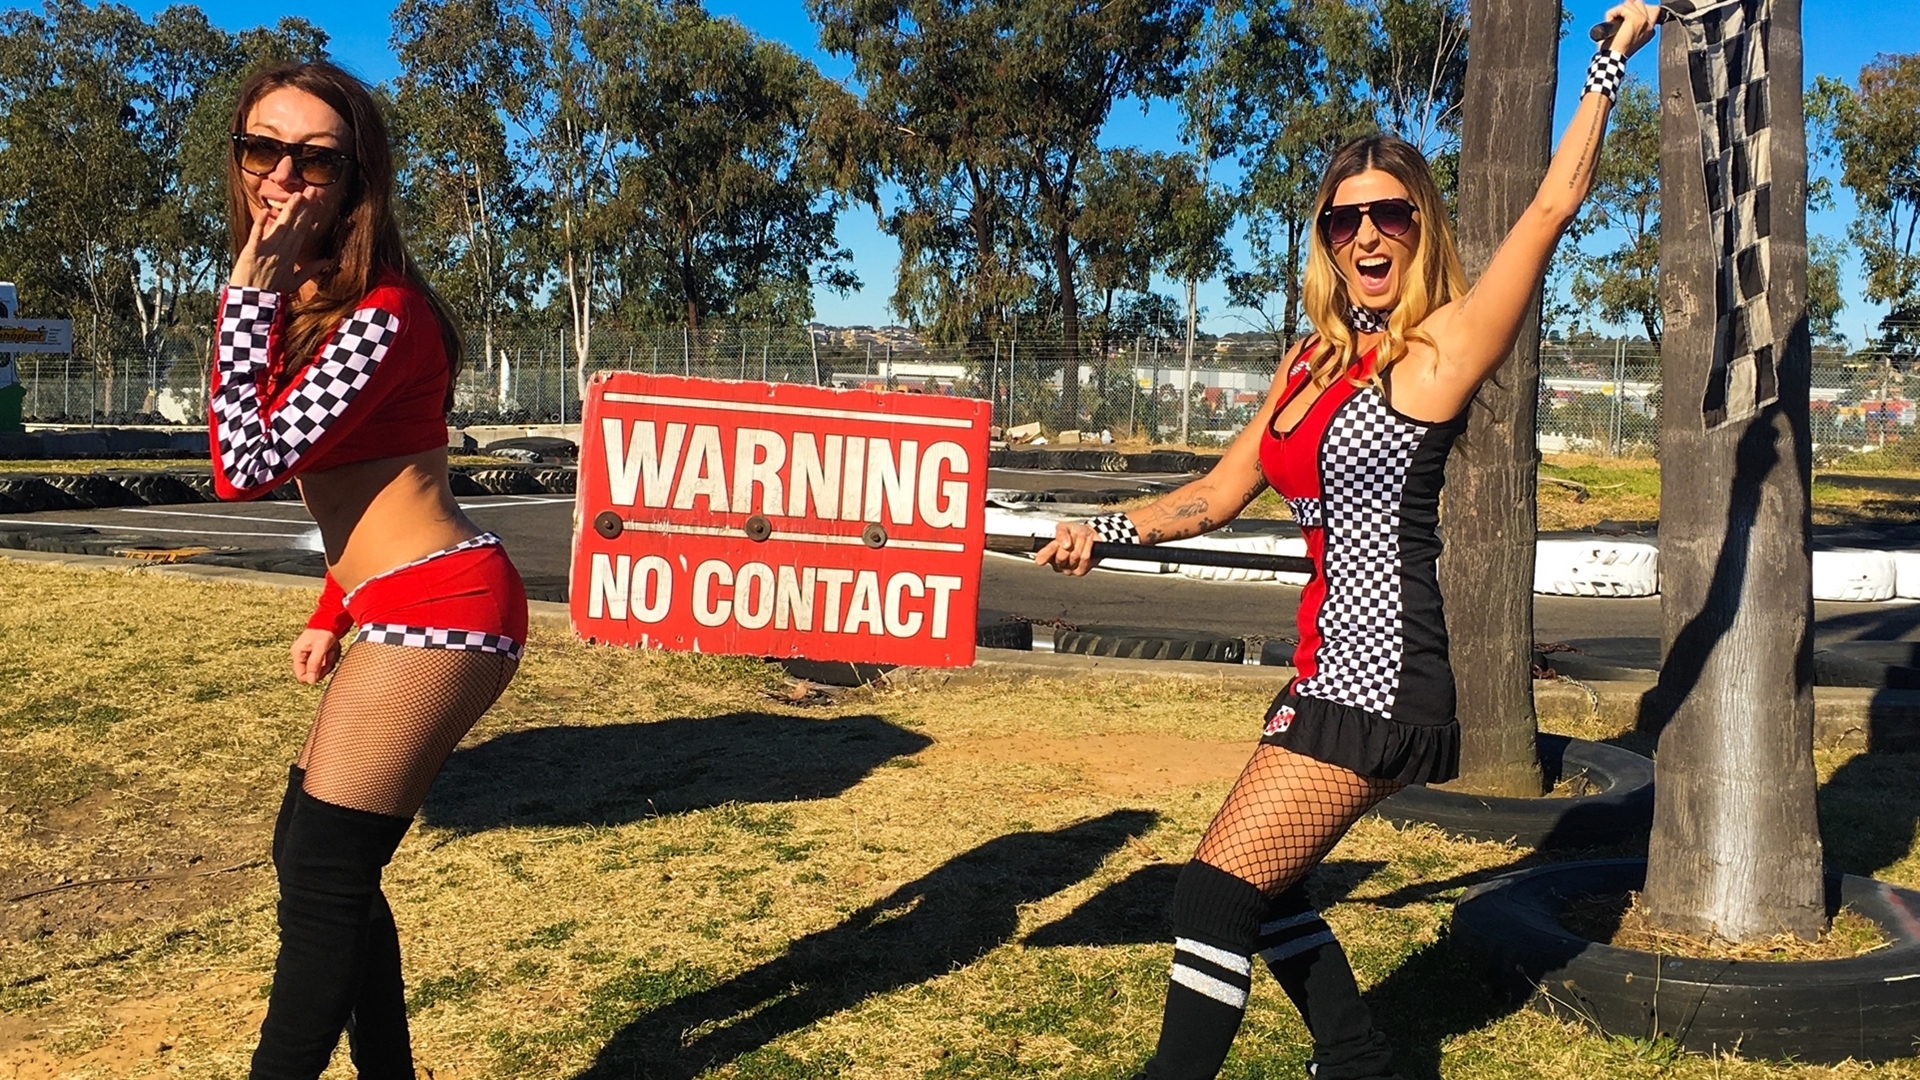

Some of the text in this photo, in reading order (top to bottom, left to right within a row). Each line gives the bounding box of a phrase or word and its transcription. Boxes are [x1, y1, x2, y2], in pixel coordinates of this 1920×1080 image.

[602, 417, 970, 529] WARNING
[587, 553, 962, 639] NO CONTACT
